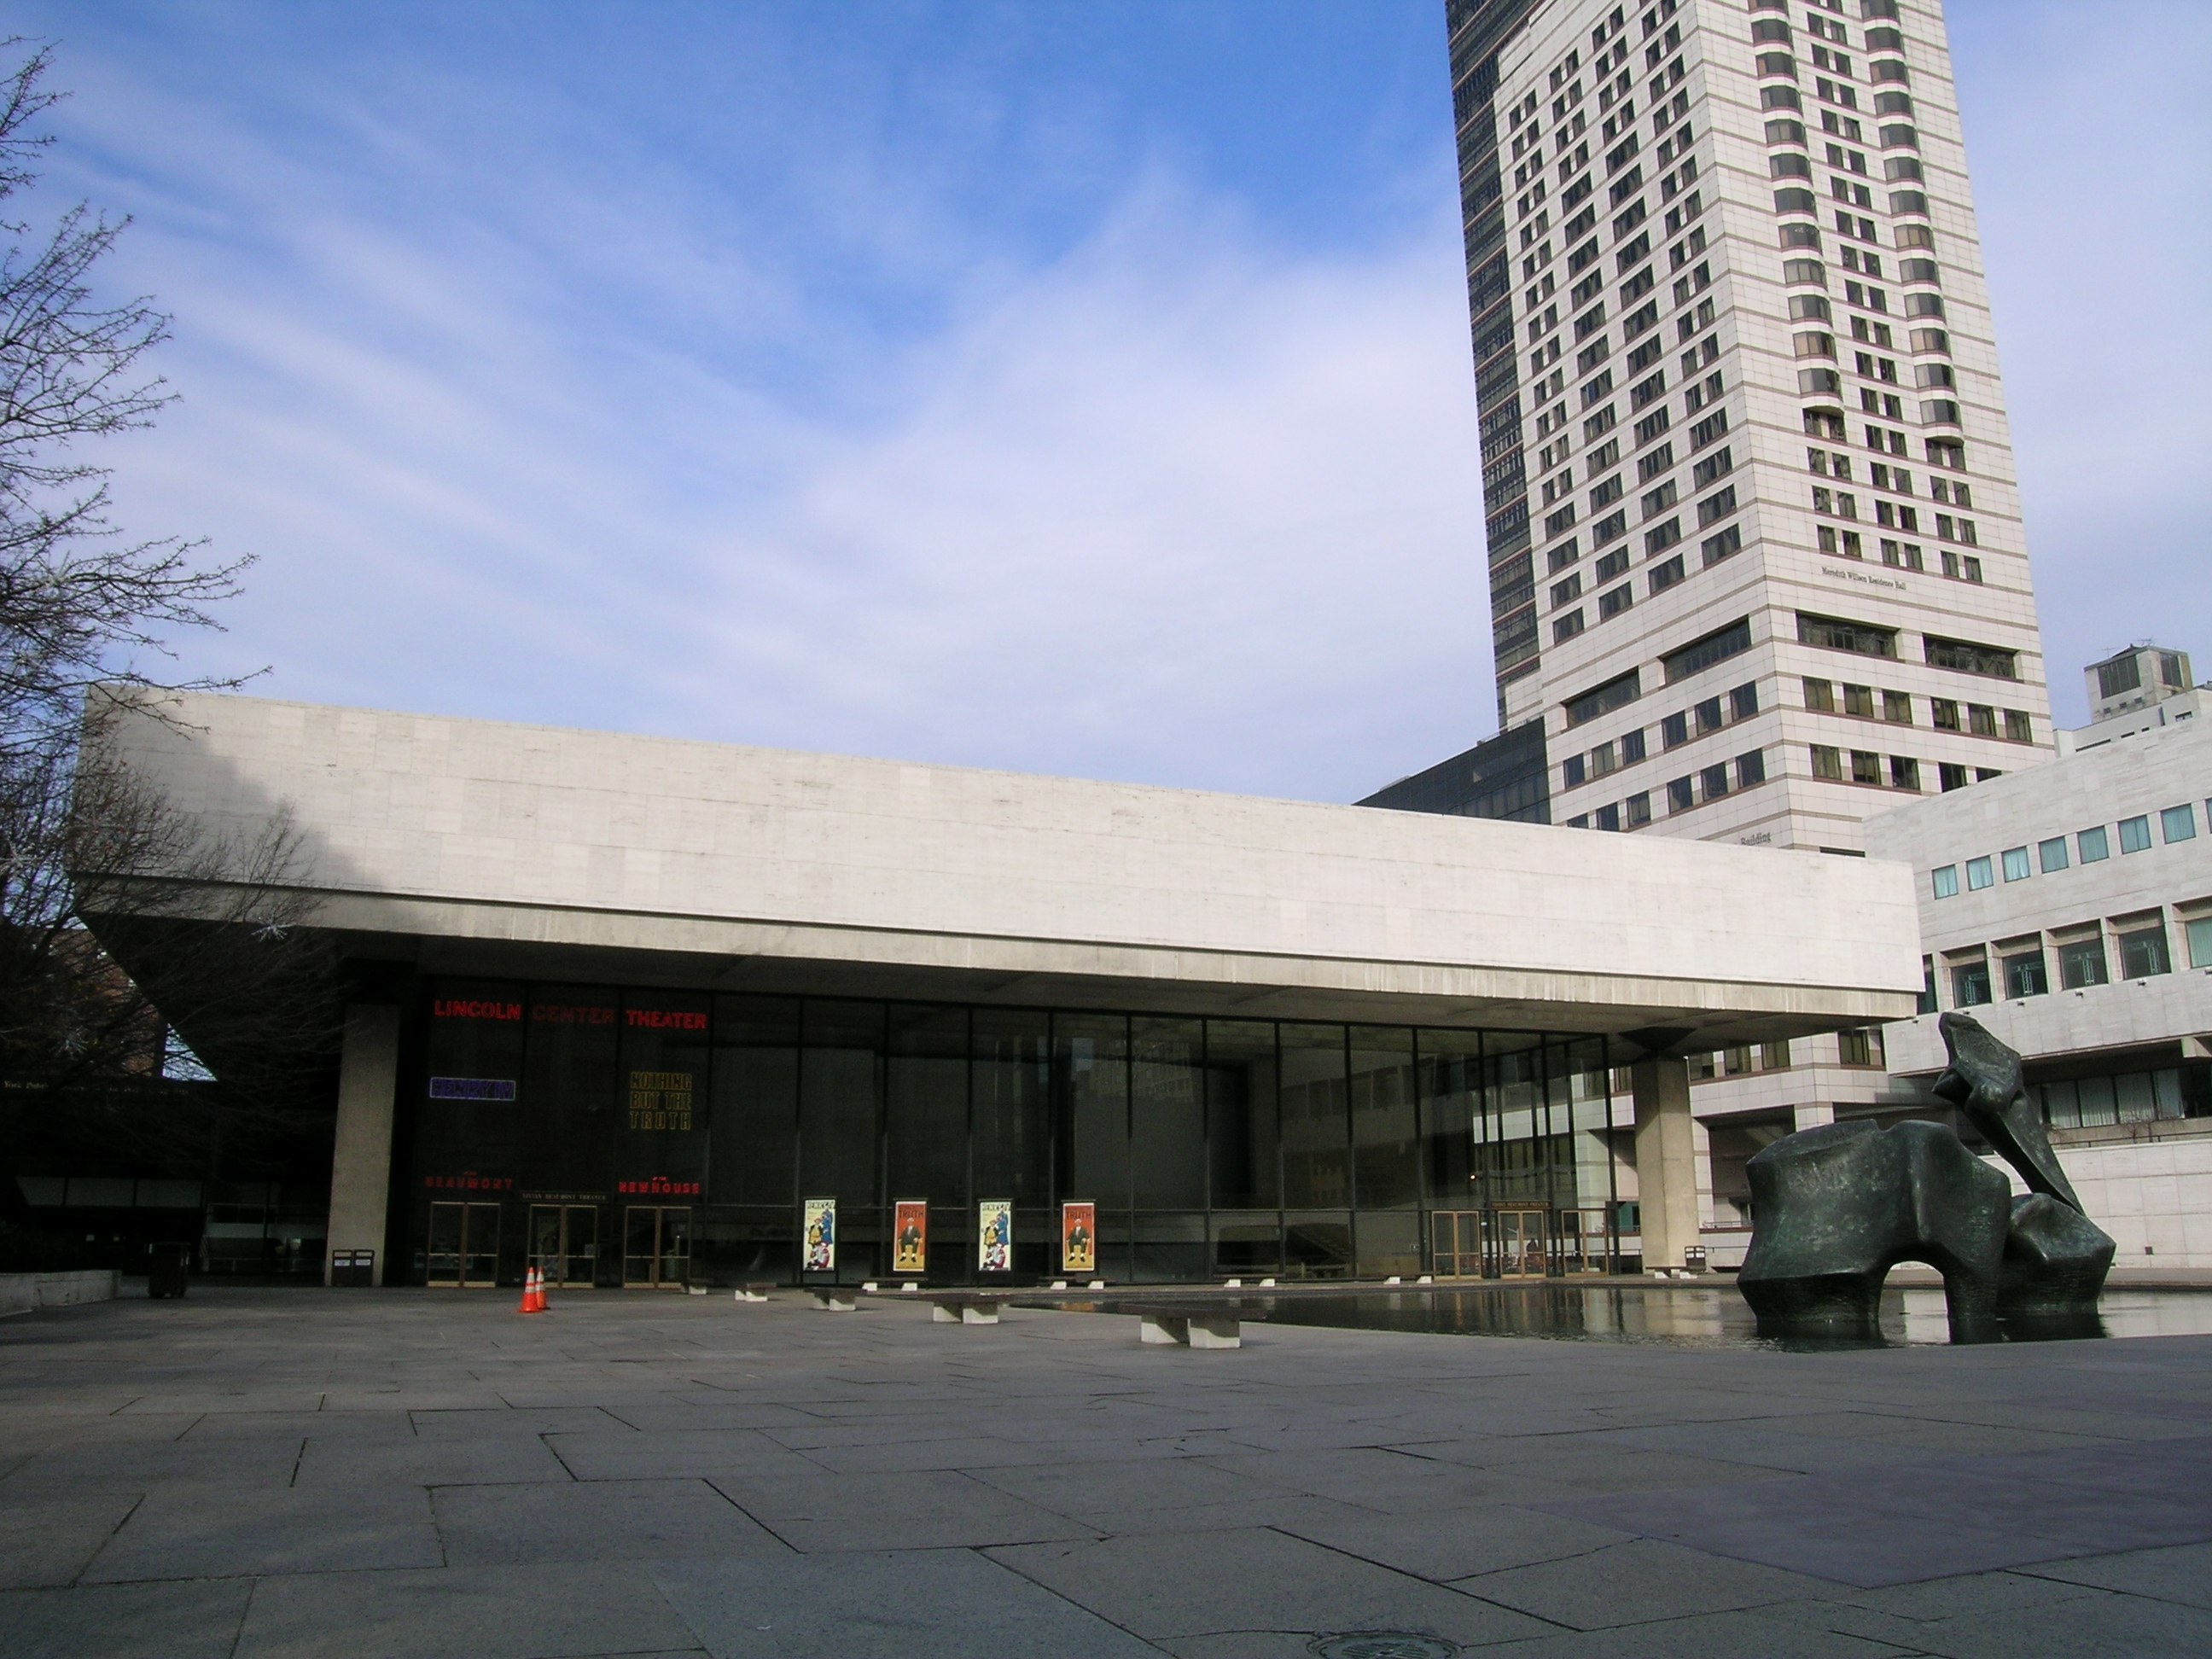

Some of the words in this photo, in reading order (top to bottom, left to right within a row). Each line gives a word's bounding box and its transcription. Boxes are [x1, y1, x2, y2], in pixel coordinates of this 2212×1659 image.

[1895, 580, 1906, 590] Hall
[433, 999, 522, 1021] LINCOLN
[531, 1004, 615, 1025] CENTER
[625, 1009, 707, 1030] THEATER
[629, 1072, 693, 1091] NOTHING
[629, 1091, 660, 1109] BUT
[665, 1092, 692, 1111] THE
[629, 1112, 692, 1131] TRUTH
[424, 1175, 513, 1190] BEAUMONT
[618, 1181, 701, 1195] NEWHOUSE
[899, 1209, 924, 1218] TRUTH
[1065, 1211, 1092, 1220] TRUTH
